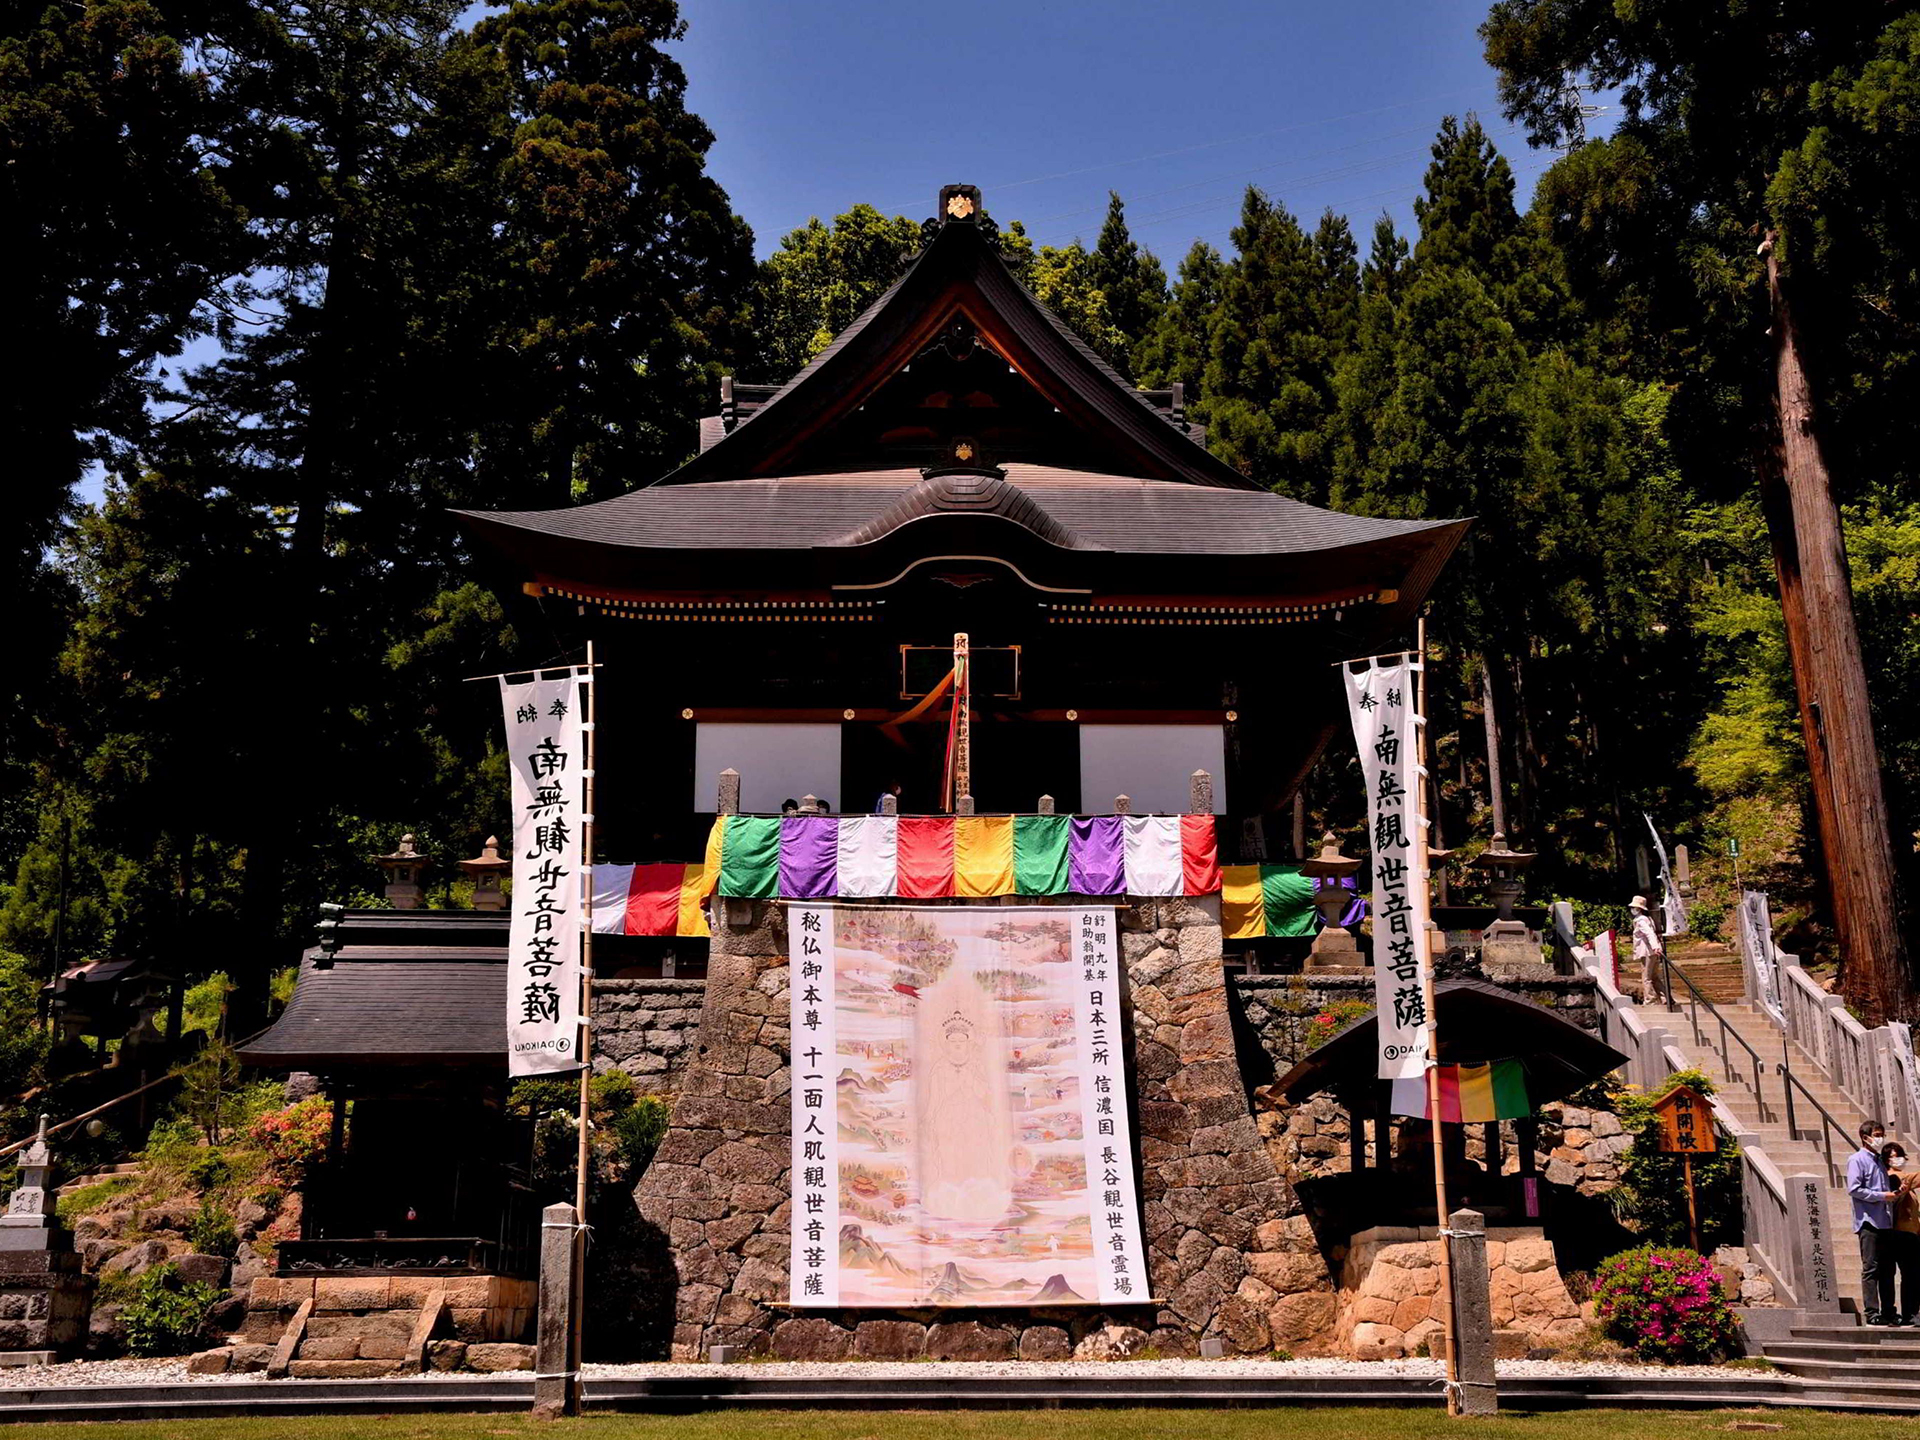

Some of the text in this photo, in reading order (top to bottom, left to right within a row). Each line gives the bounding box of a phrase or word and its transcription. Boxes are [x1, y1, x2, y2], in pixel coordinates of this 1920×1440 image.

[1094, 914, 1108, 982] 舒明九年
[1373, 724, 1427, 1030] 南無観世音菩薩
[801, 910, 827, 1296] 秘仏御本尊 十一面人肌観世音菩薩
[1089, 990, 1133, 1296] 日本三所 信濃国 長谷観世音霊場
[1675, 1095, 1698, 1150] 御開帳
